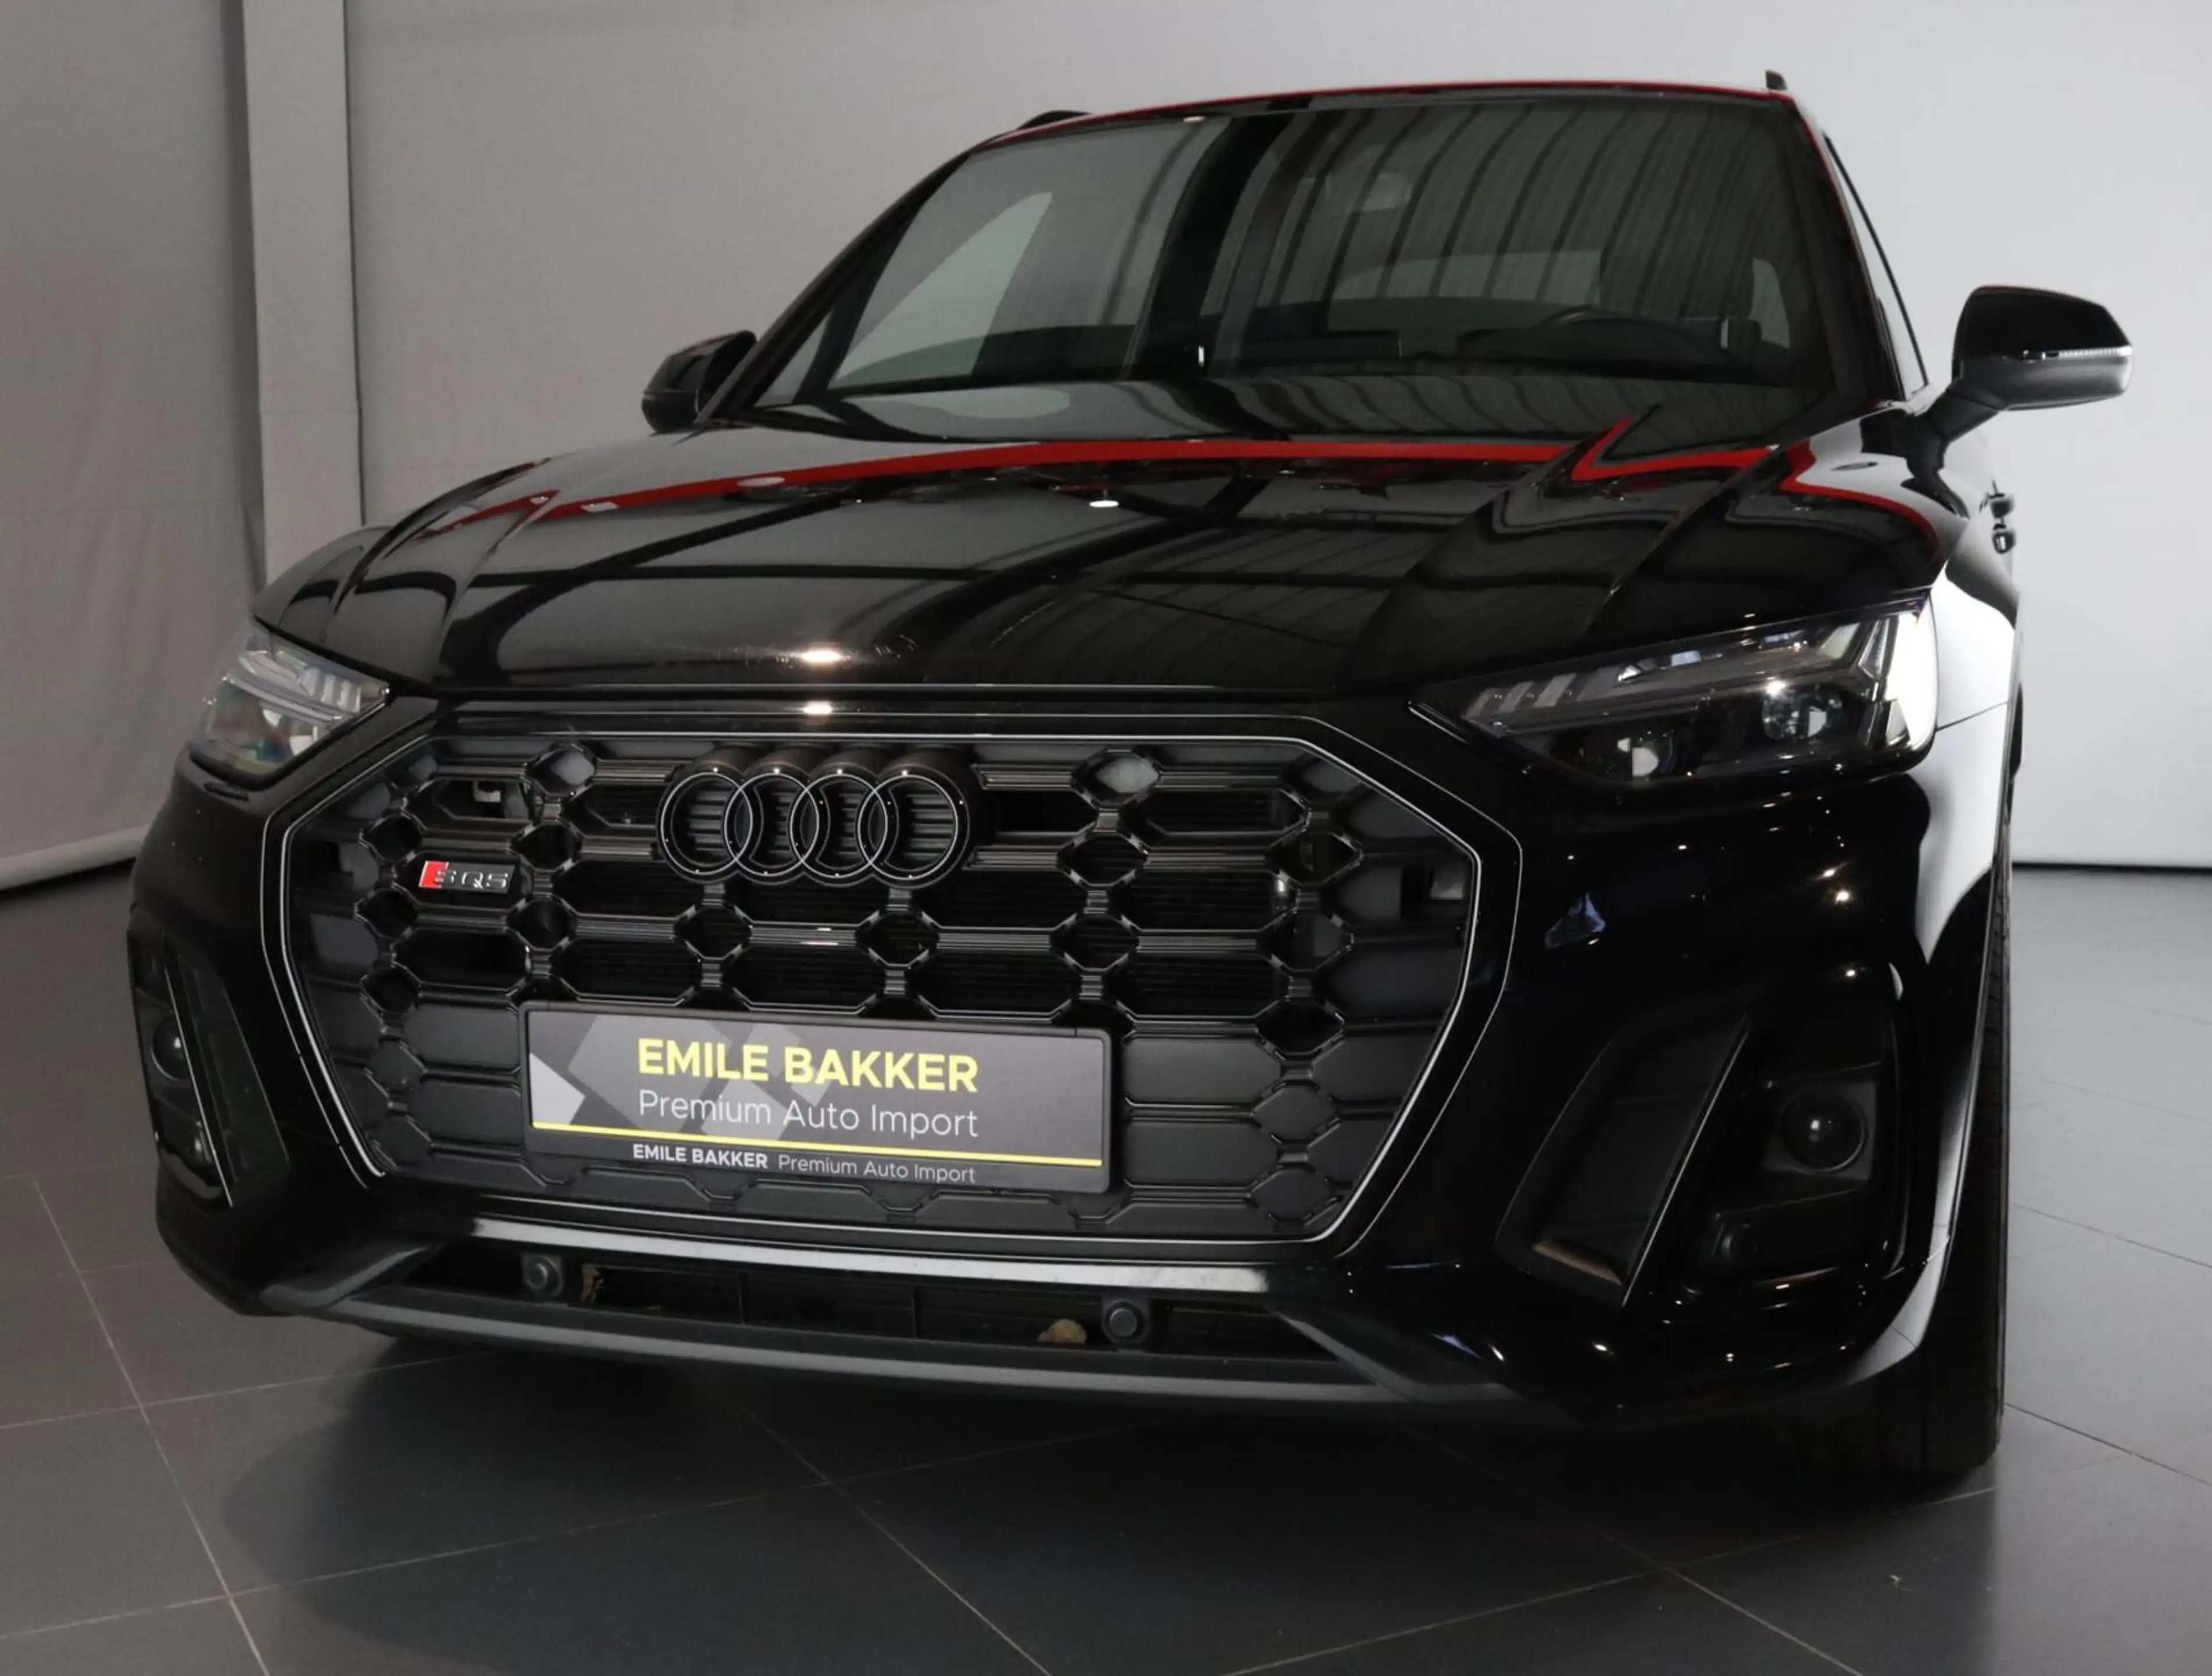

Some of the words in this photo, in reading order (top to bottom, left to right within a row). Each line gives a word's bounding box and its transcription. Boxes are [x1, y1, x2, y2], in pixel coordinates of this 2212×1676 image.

[638, 1038, 769, 1081] EMILE
[784, 1046, 979, 1092] BAKKER
[640, 1089, 771, 1124] Premium
[783, 1099, 859, 1130] Auto
[872, 1104, 979, 1139] Import
[632, 1144, 687, 1162] EMILE
[692, 1148, 768, 1169] BAKKER
[778, 1154, 858, 1175] Premium
[863, 1160, 909, 1178] Auto
[914, 1163, 976, 1183] Import
